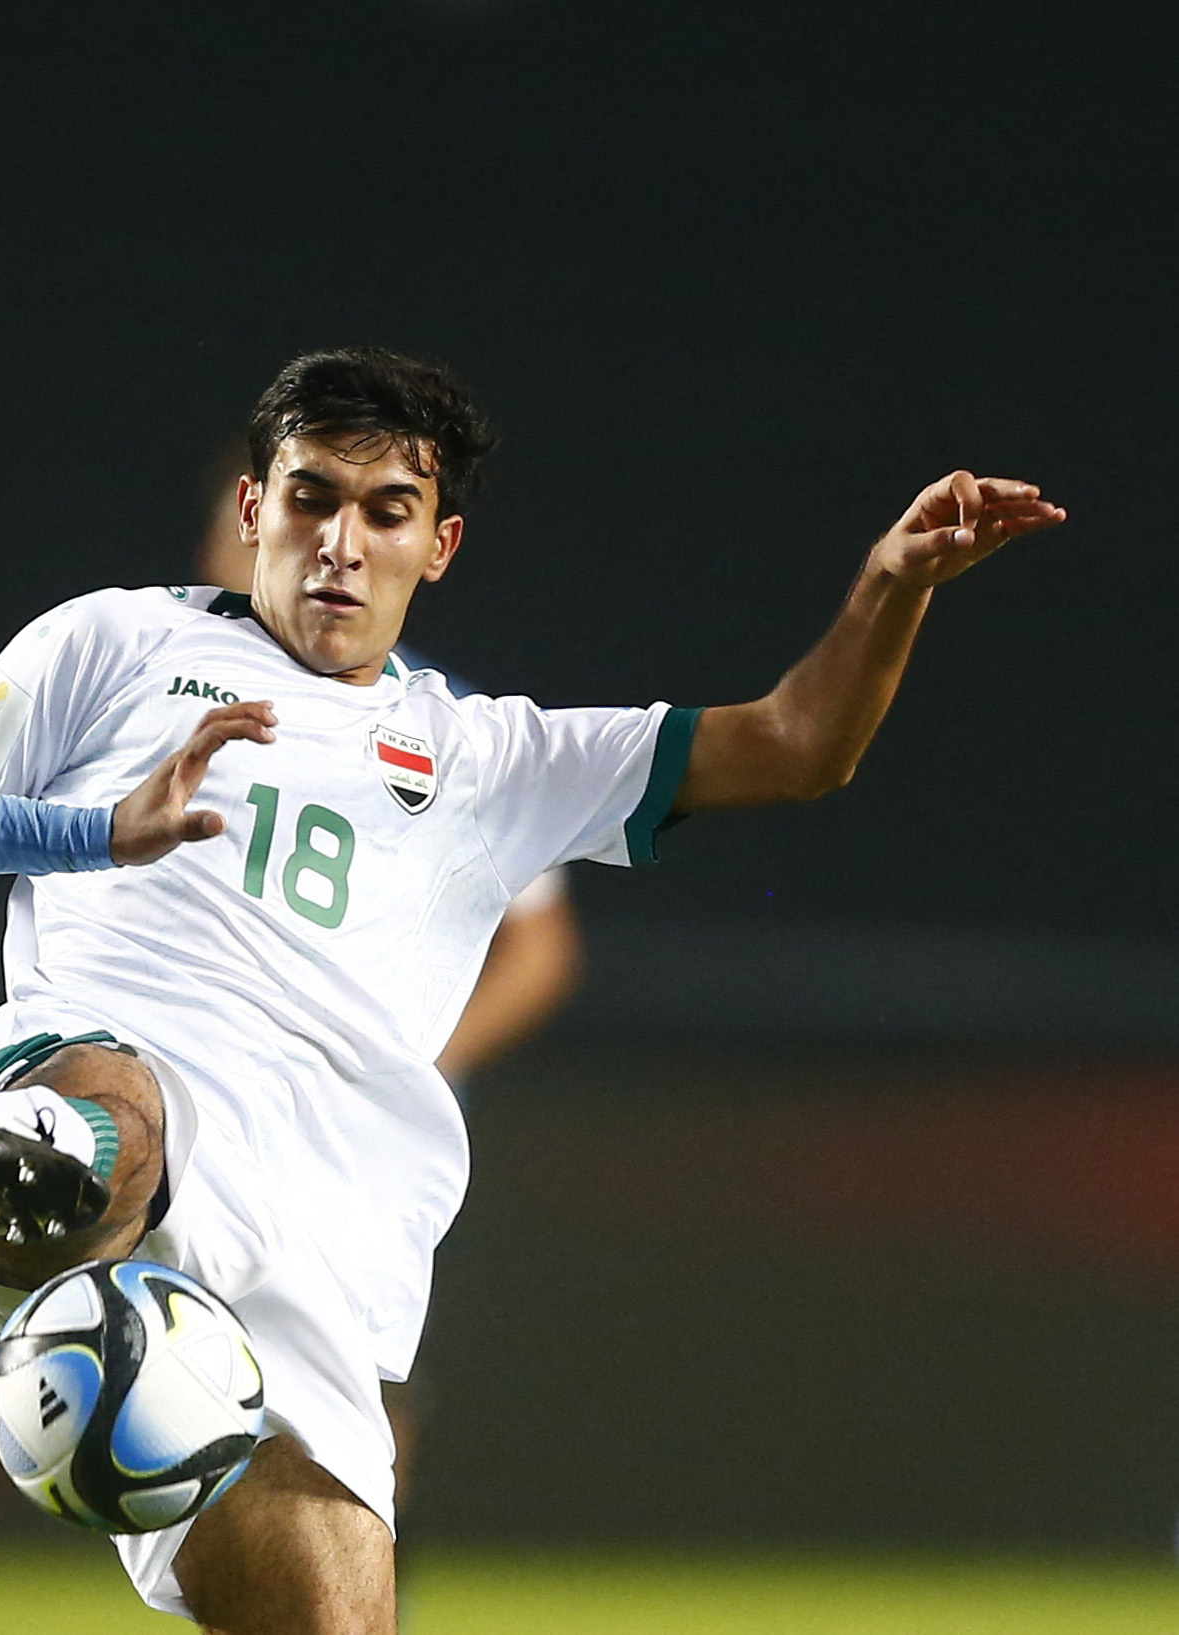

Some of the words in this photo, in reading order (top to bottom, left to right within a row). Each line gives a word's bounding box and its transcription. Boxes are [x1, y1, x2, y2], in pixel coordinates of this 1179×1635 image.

[167, 676, 240, 706] JAKO
[382, 731, 422, 751] IRAQ
[243, 782, 355, 929] 18
